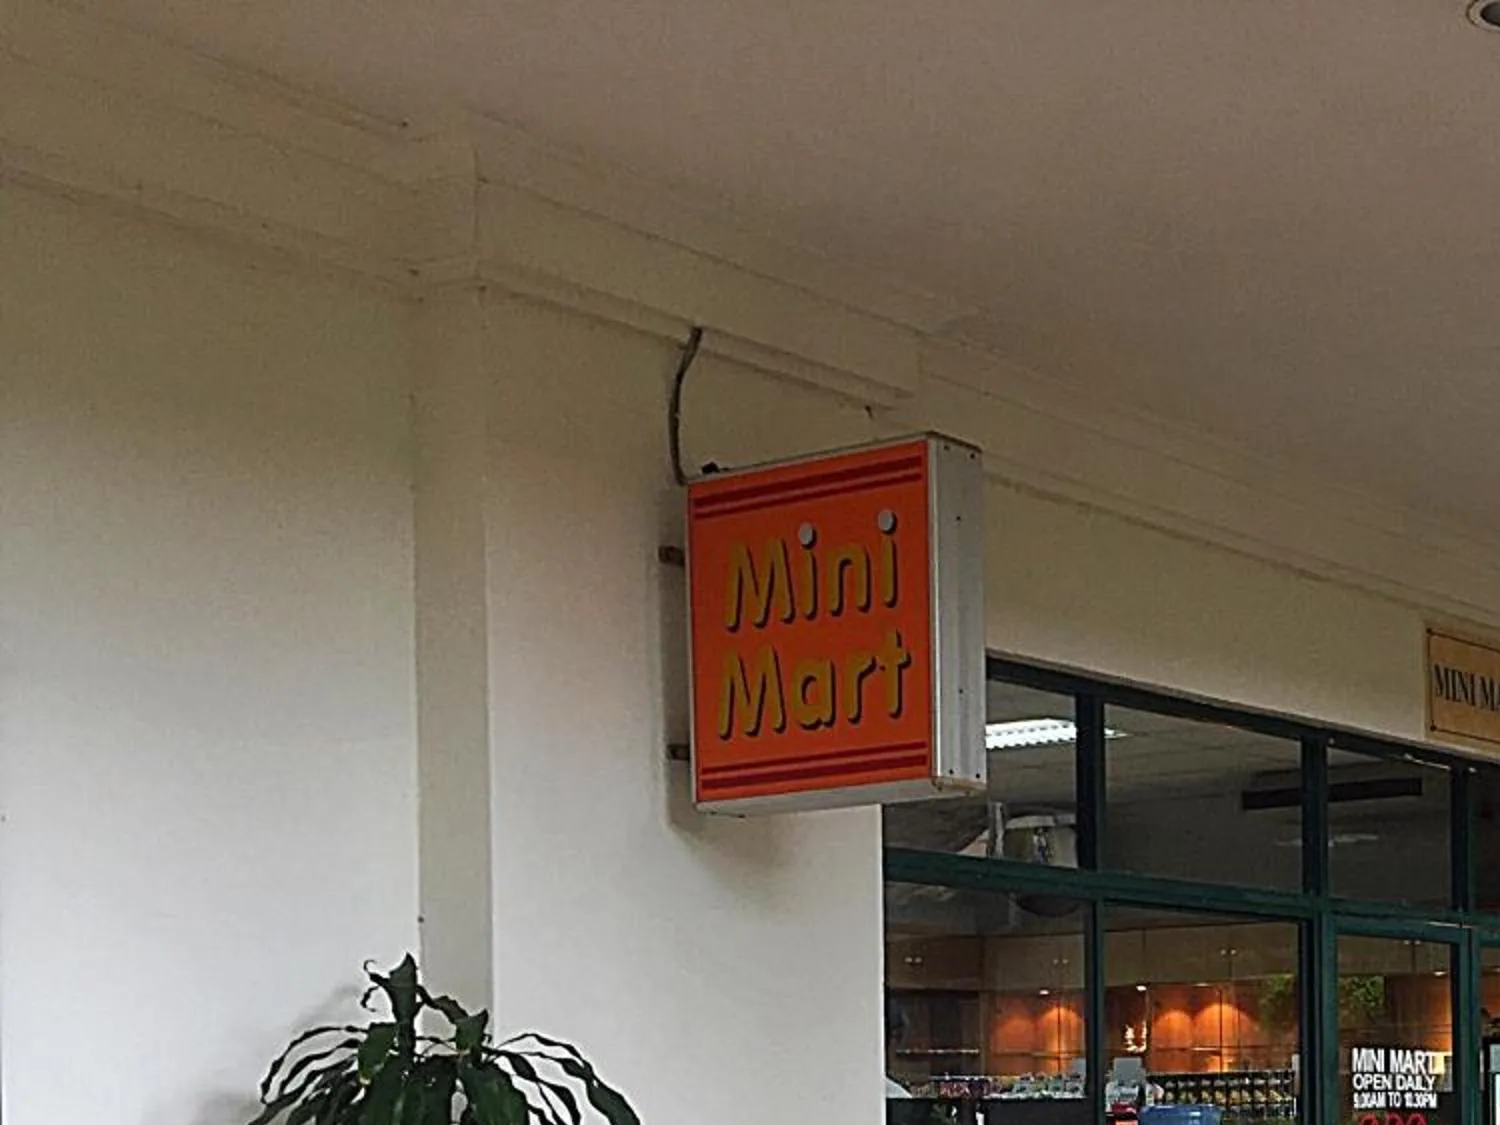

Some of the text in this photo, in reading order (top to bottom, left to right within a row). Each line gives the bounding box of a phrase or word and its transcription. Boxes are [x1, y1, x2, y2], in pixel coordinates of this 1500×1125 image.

[724, 510, 898, 633] Mini
[717, 629, 912, 741] Mart
[1434, 663, 1477, 707] MINI
[1351, 1047, 1436, 1075] MINI MART
[1352, 1073, 1436, 1091] OPEN DAILY
[1388, 1091, 1402, 1108] TO
